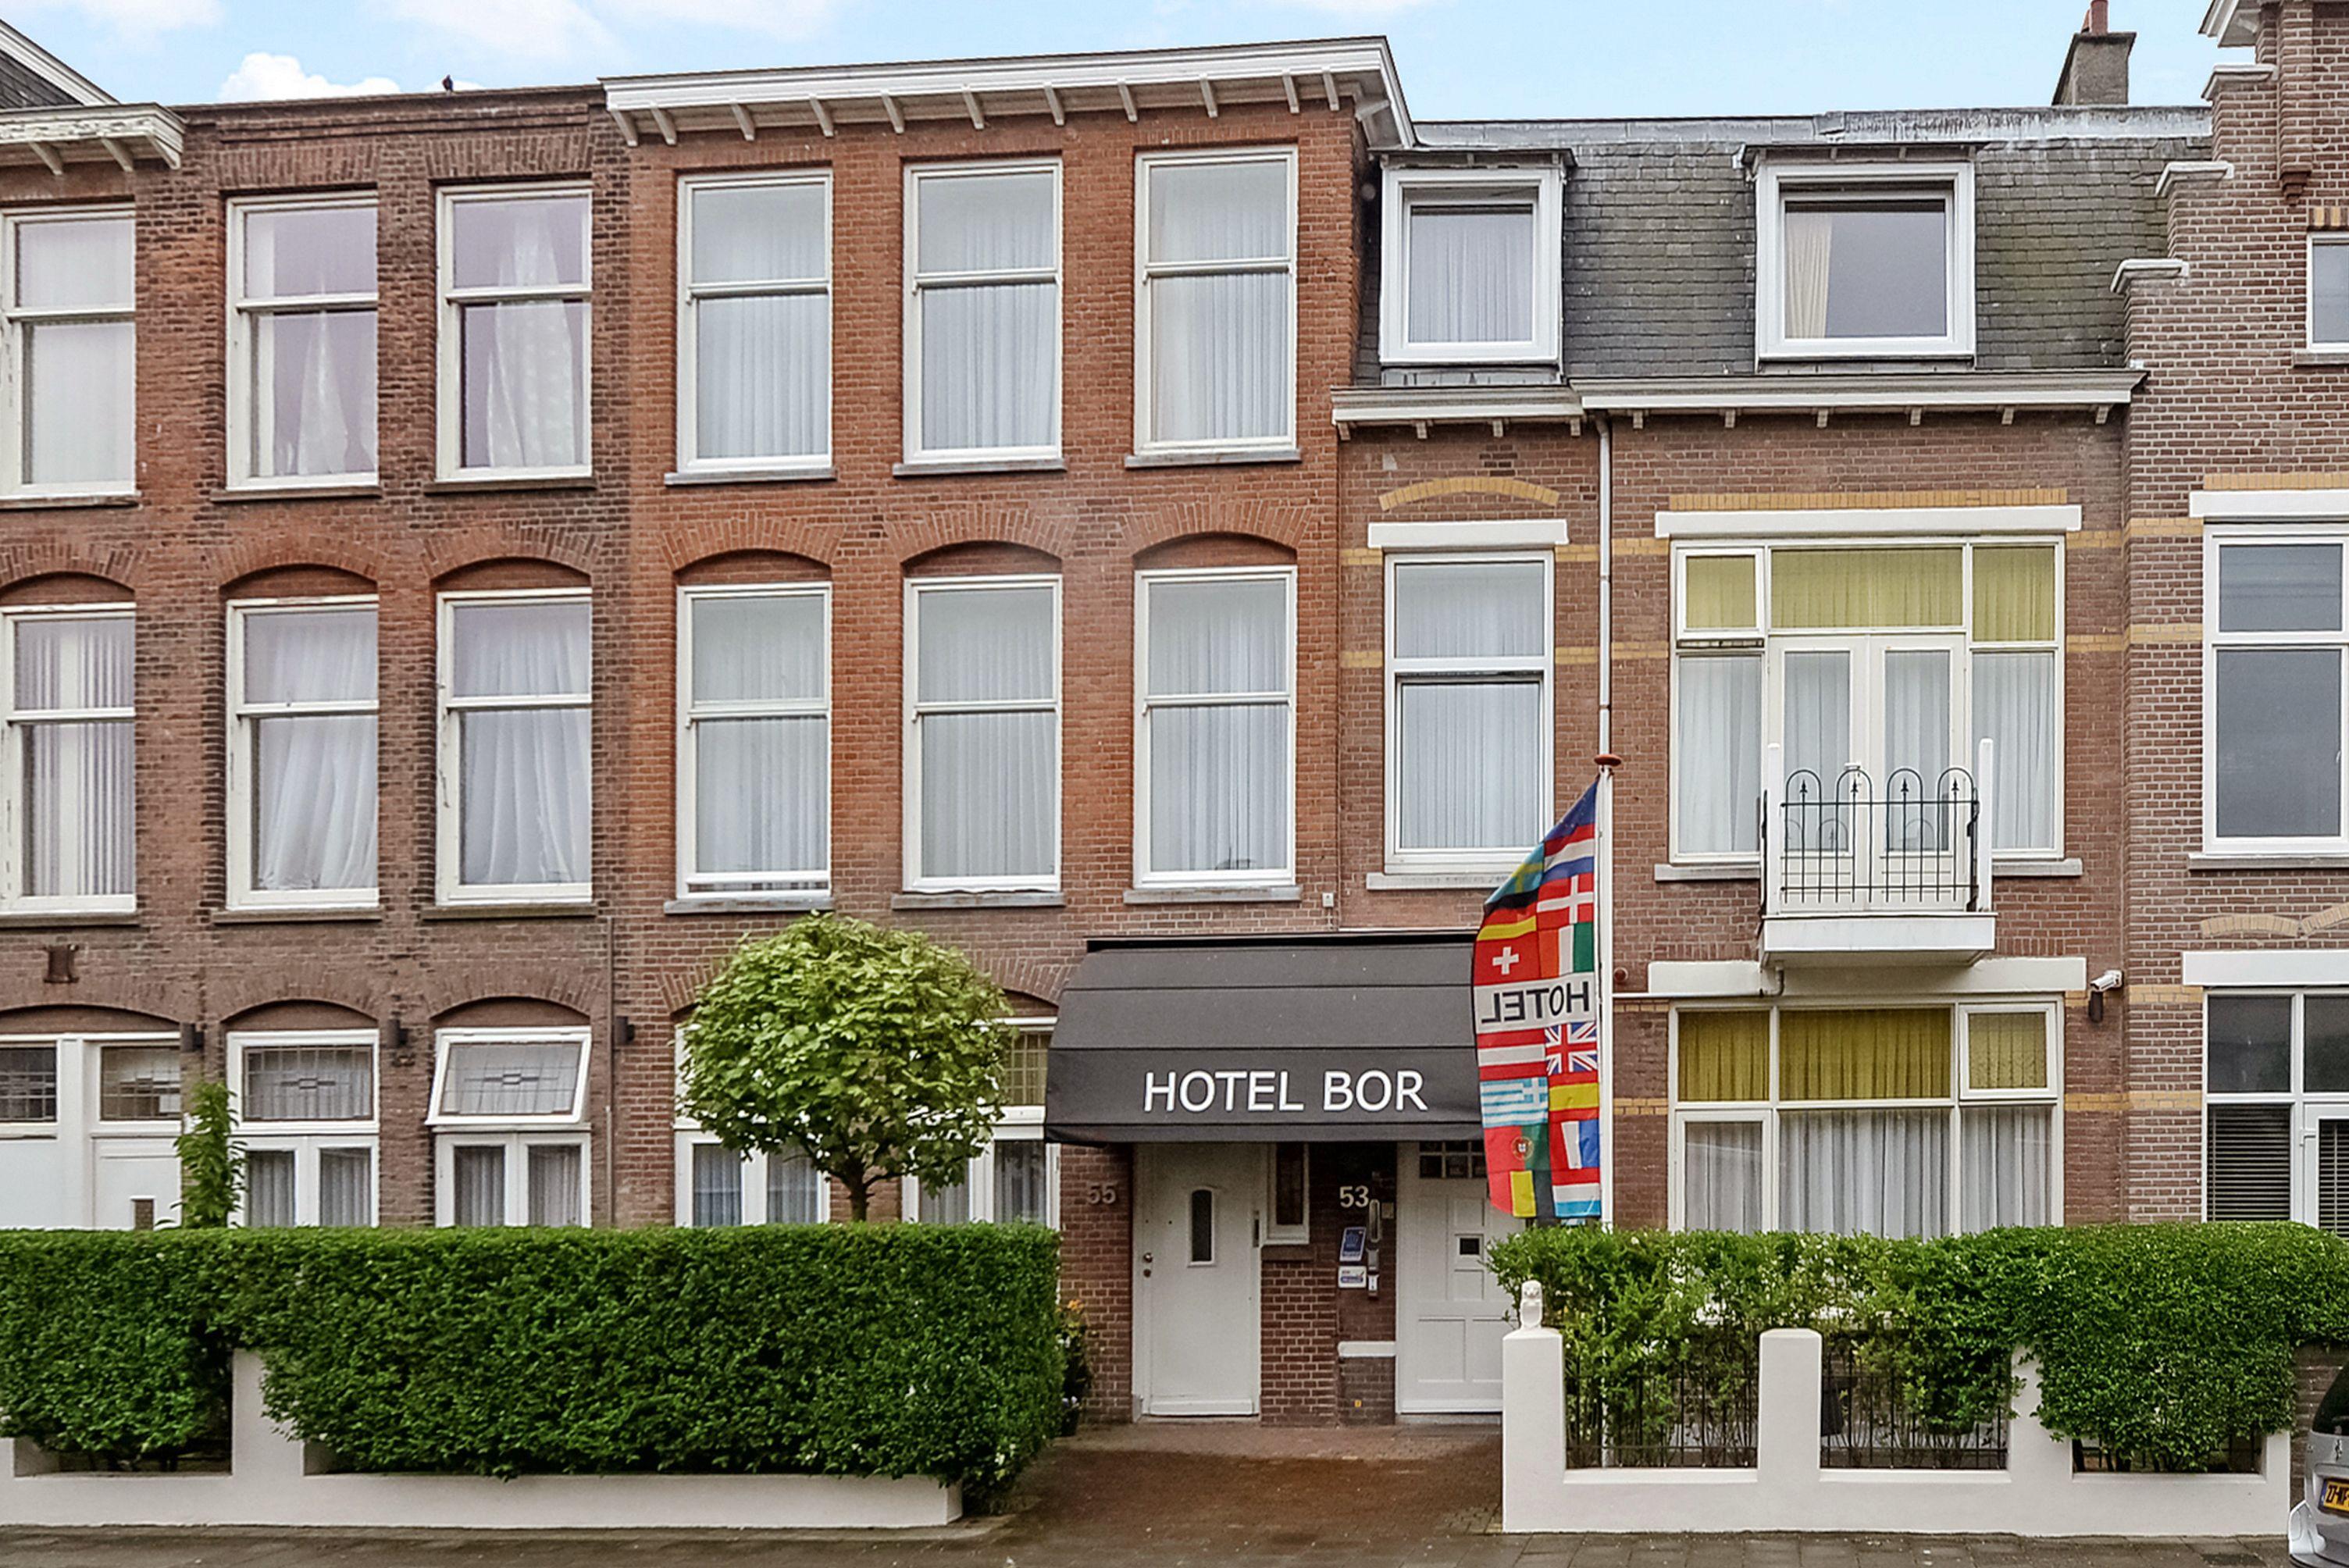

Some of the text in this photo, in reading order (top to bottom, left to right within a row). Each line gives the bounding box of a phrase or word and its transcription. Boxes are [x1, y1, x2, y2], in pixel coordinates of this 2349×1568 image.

[1143, 1070, 1429, 1112] HOTEL BOR
[1086, 1181, 1117, 1204] 55
[1339, 1185, 1369, 1208] 53
